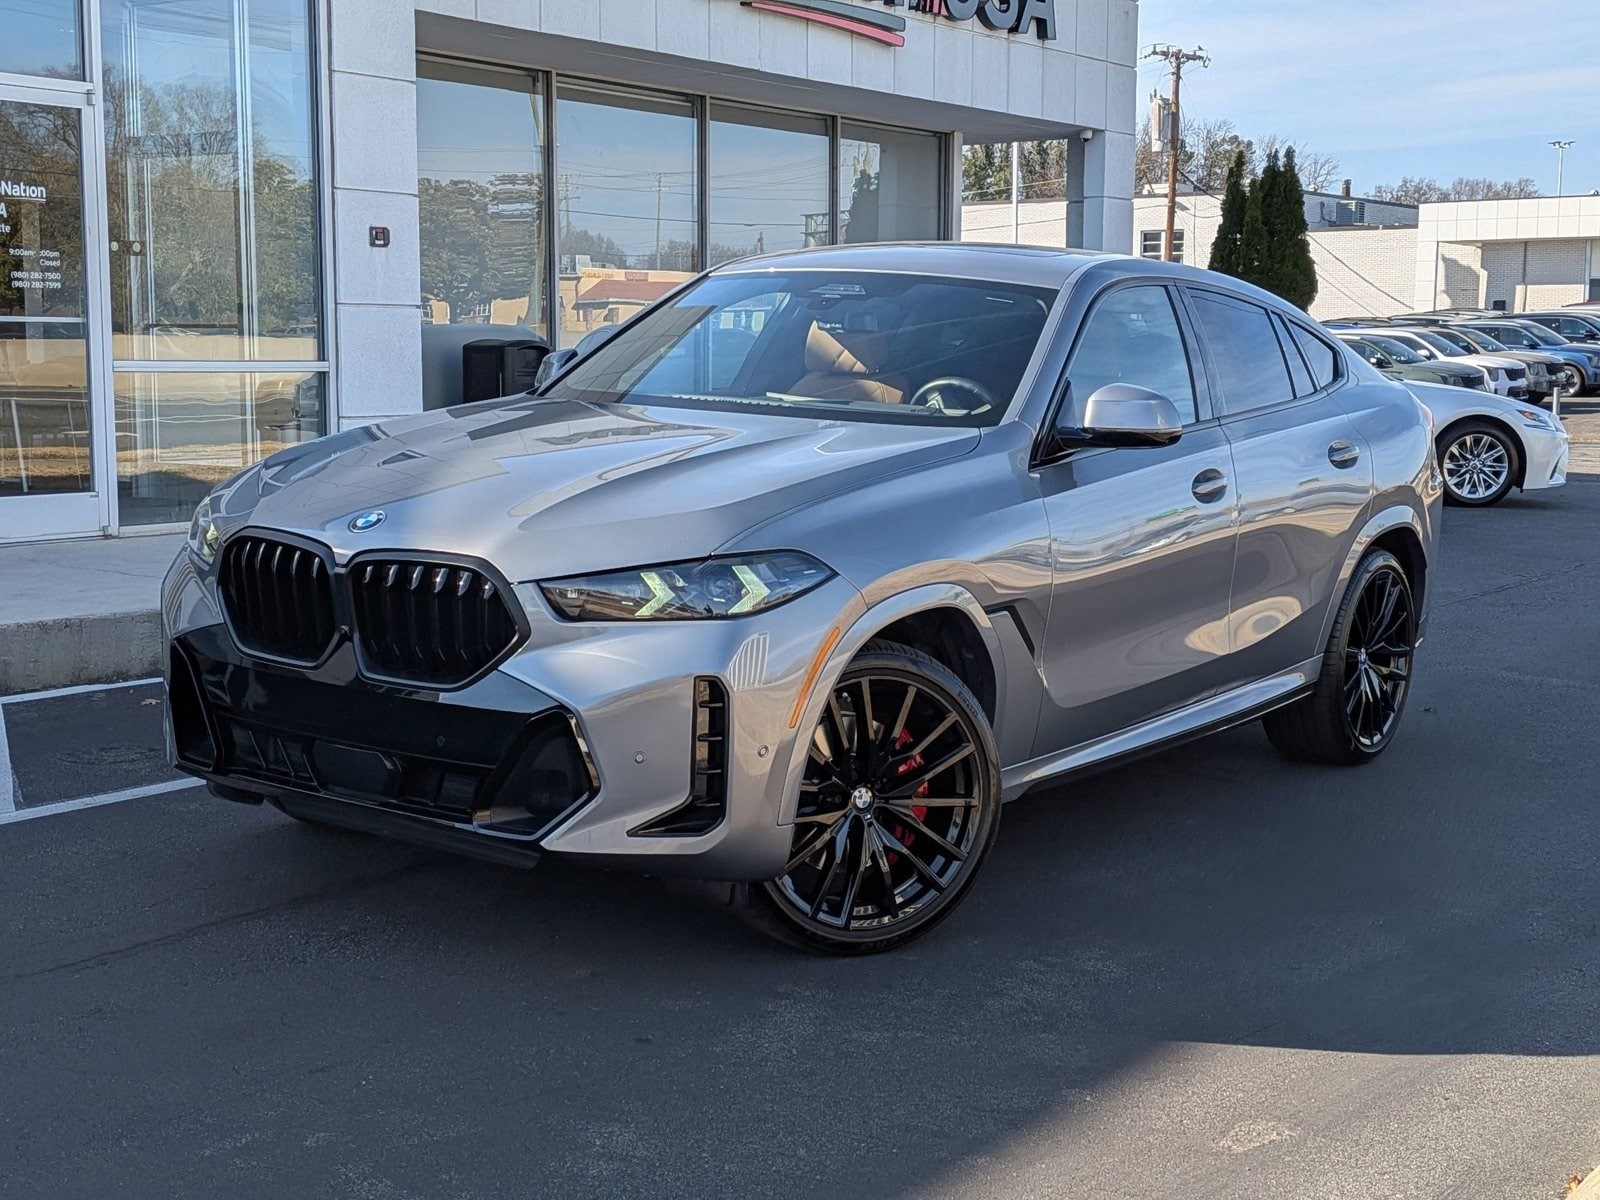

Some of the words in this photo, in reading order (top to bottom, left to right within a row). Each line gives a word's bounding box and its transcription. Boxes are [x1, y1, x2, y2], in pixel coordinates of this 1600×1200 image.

[0, 181, 46, 198] Nation
[40, 259, 61, 267] Closed
[11, 271, 30, 280] (980)
